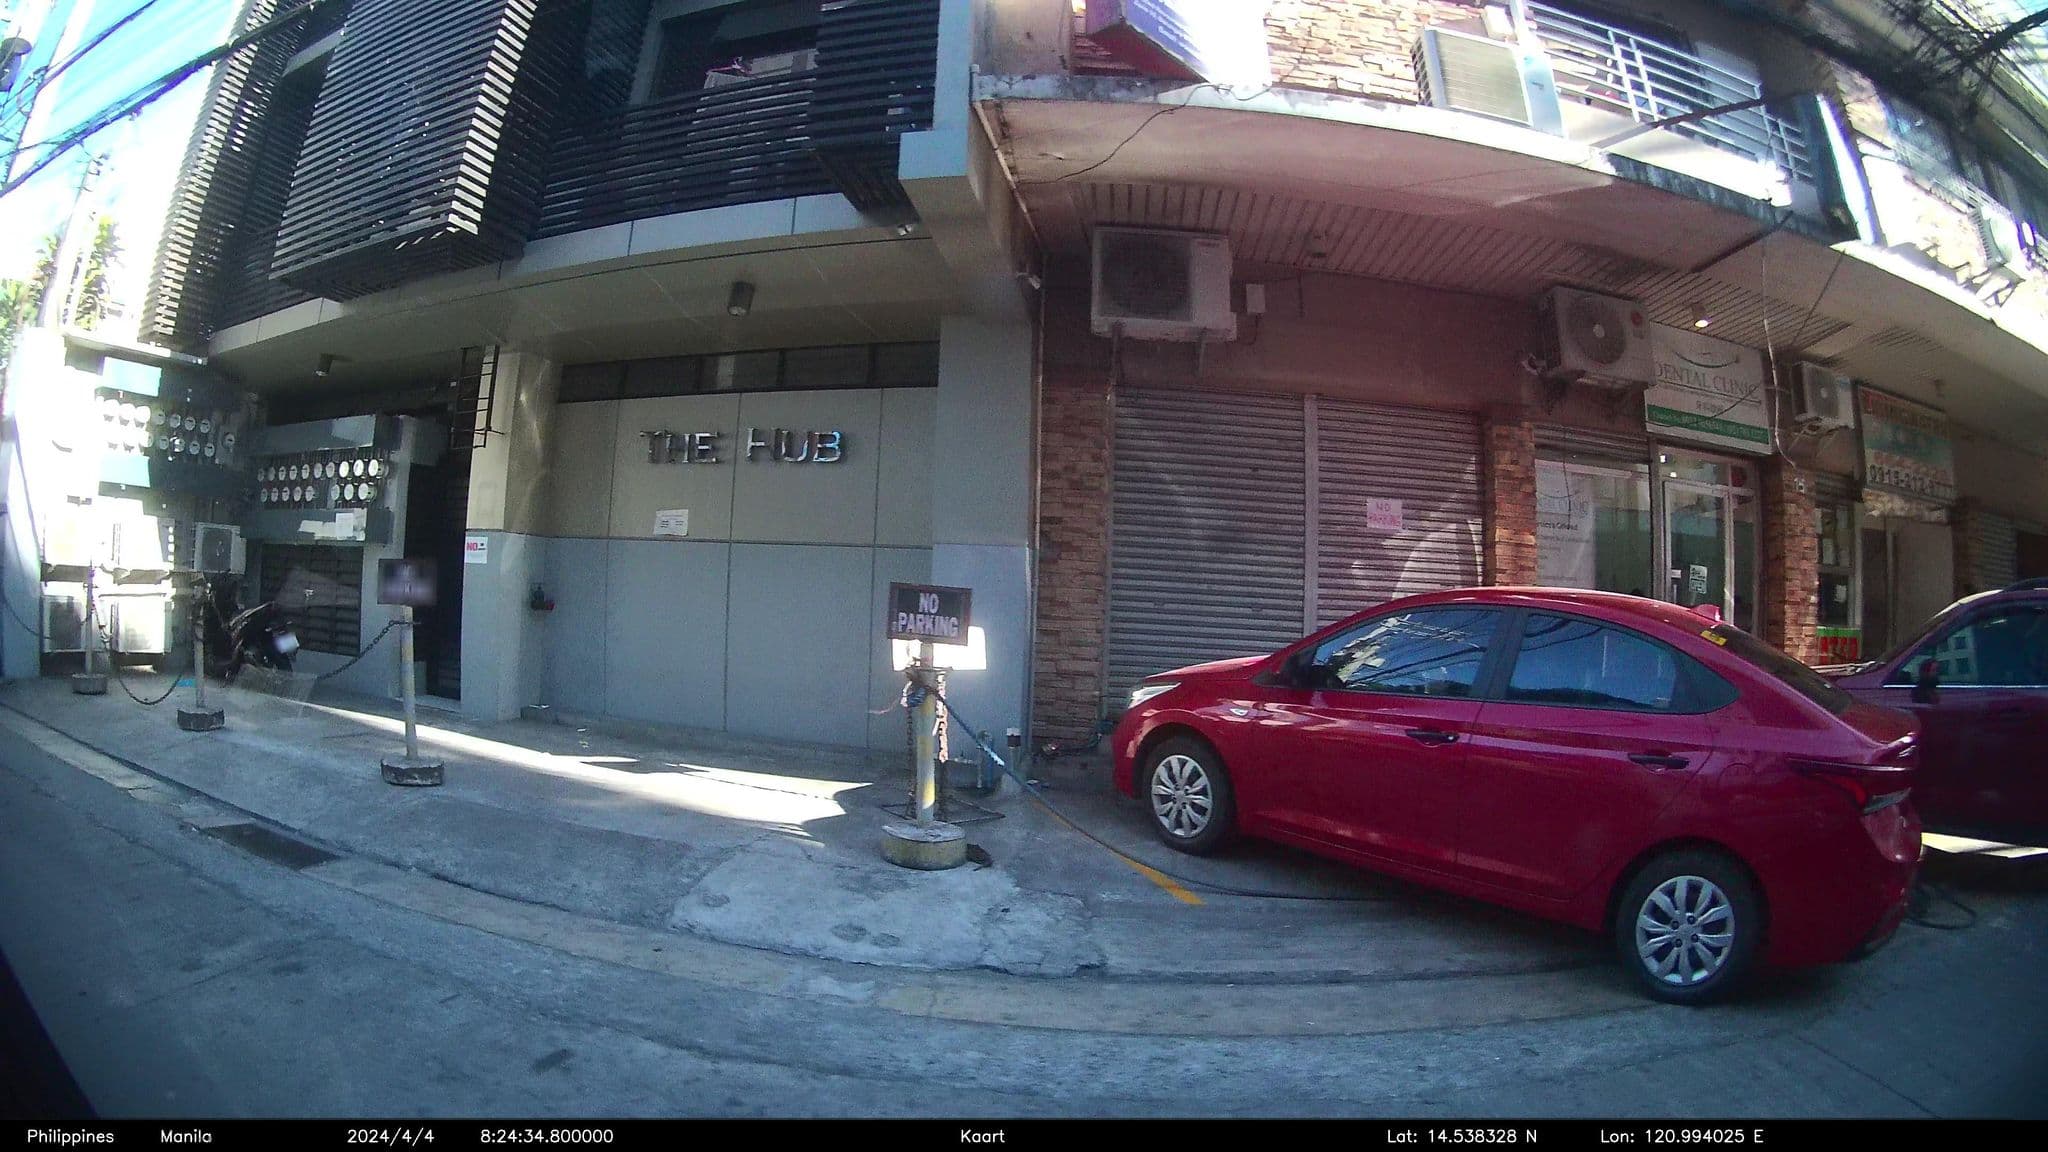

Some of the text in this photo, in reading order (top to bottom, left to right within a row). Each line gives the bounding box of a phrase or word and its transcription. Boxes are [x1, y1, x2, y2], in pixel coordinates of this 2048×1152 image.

[640, 427, 844, 464] THE HUB
[918, 592, 939, 614] NO
[898, 611, 959, 637] PARKING
